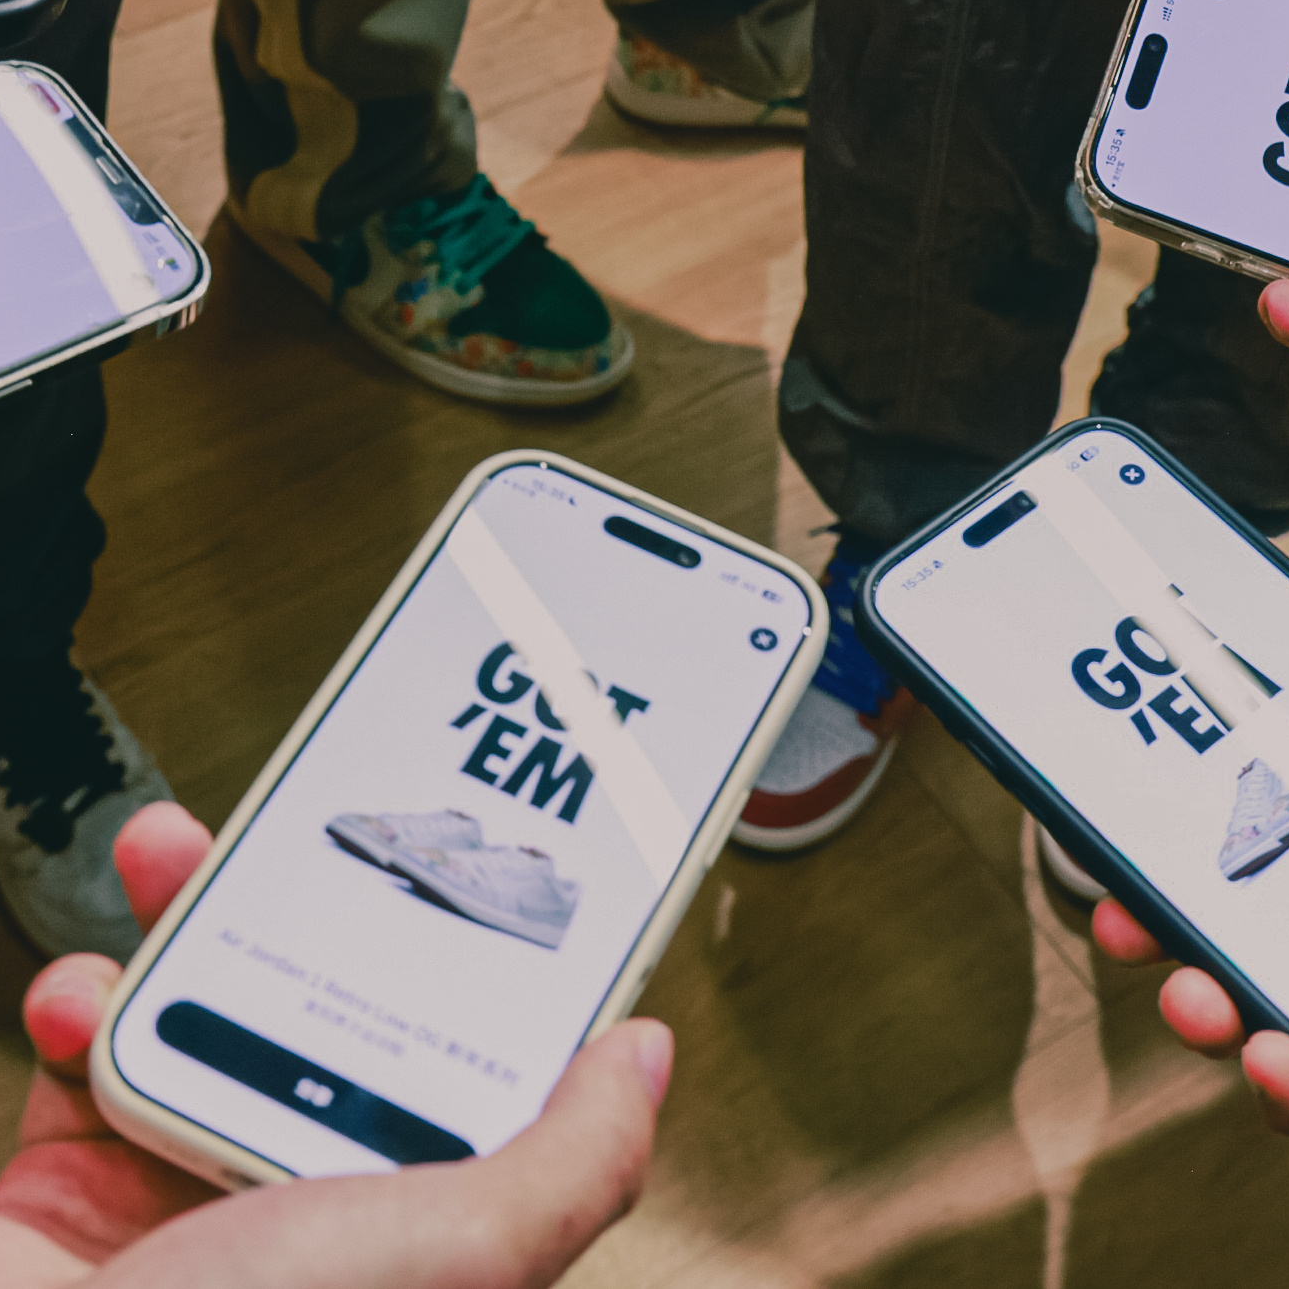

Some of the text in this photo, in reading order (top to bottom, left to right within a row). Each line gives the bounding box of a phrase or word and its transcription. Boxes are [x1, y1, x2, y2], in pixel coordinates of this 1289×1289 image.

[1105, 137, 1122, 167] 15:35
[901, 565, 934, 592] 15:35
[1071, 584, 1183, 709] GO
[1130, 644, 1281, 753] 'E
